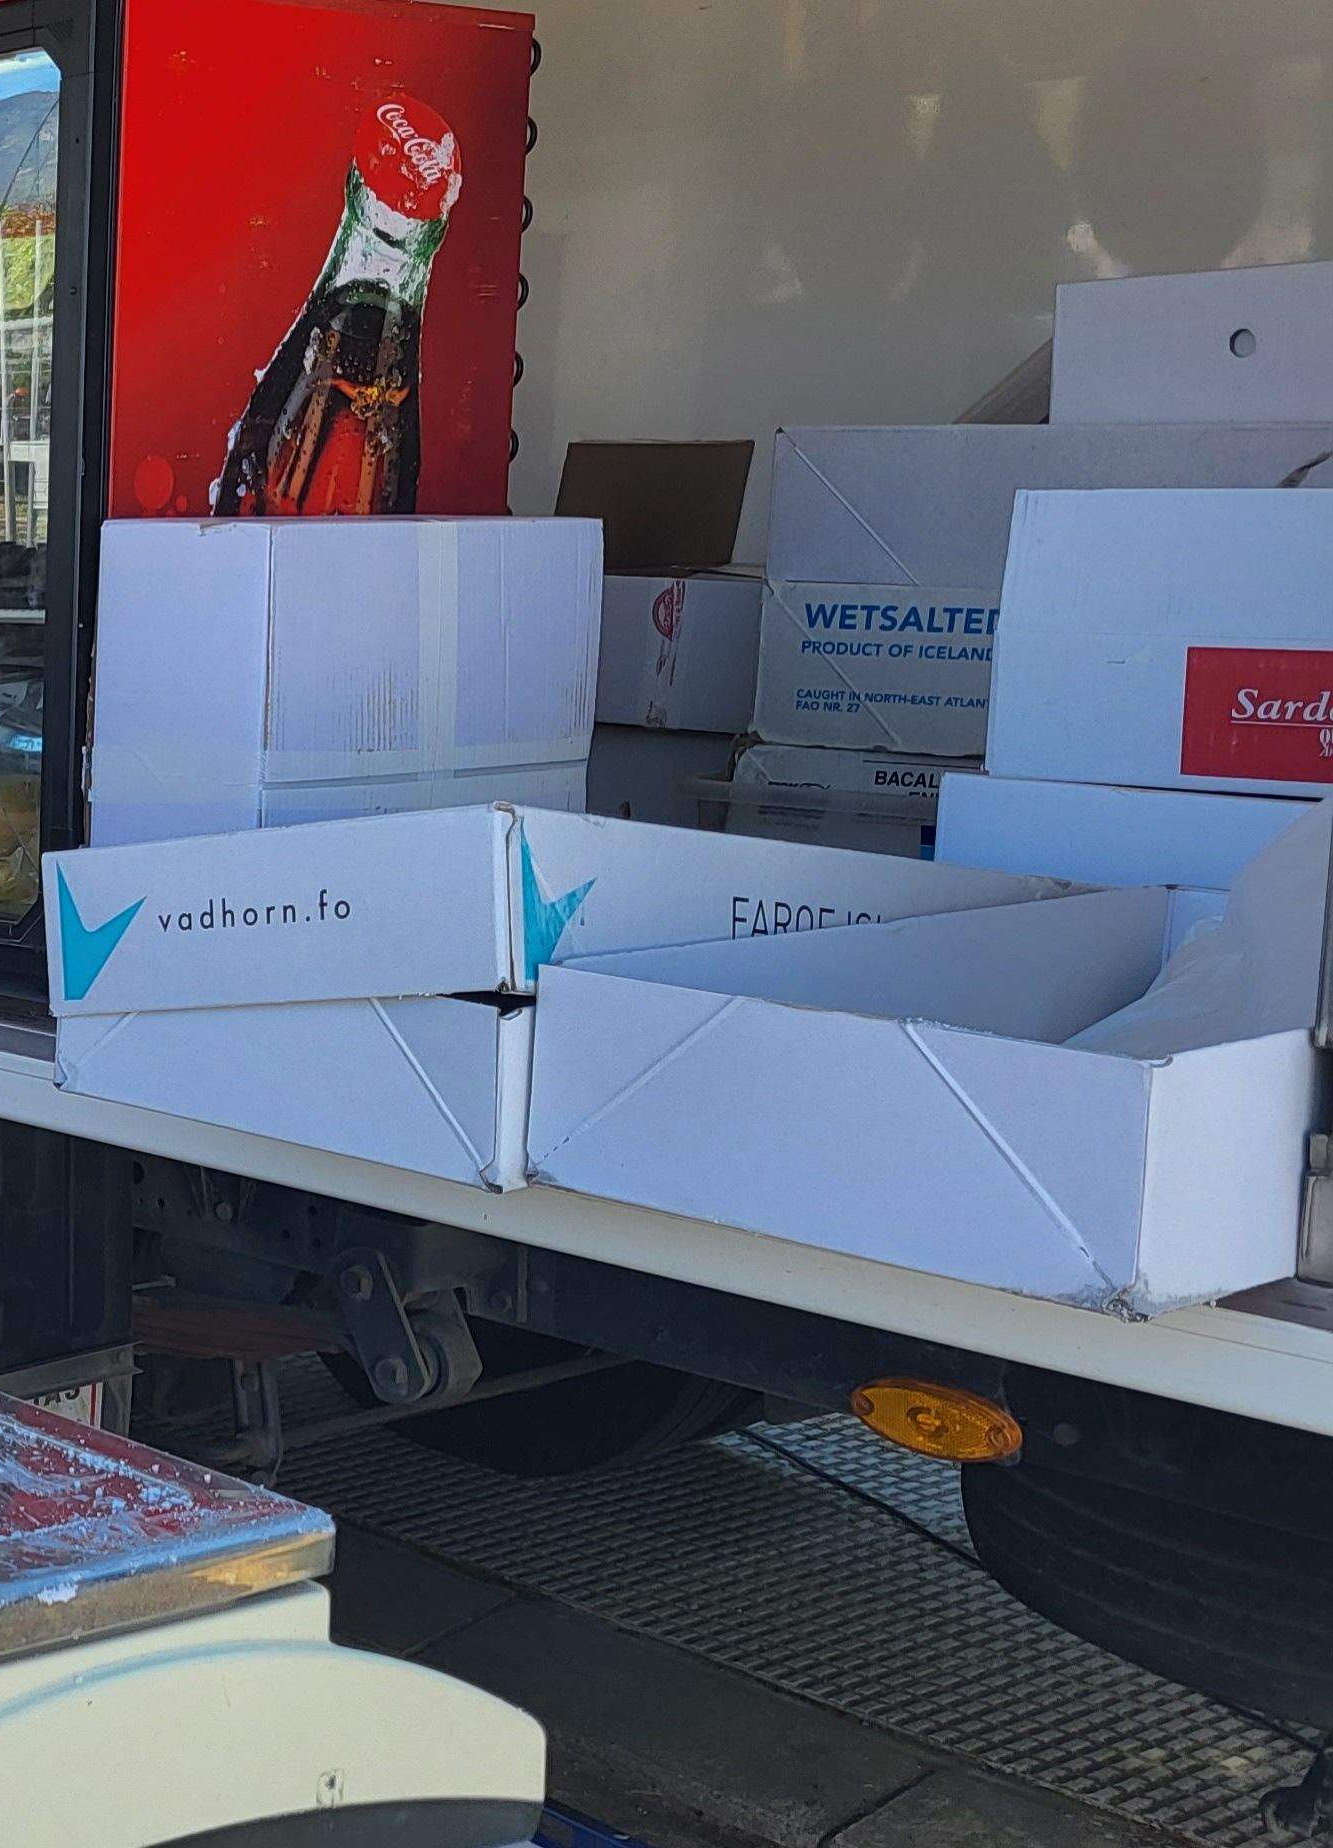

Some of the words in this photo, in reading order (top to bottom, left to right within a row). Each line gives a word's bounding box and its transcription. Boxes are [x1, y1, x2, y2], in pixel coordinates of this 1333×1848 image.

[801, 640, 883, 658] PRODUCT
[888, 643, 914, 659] OF
[795, 700, 820, 711] FAO
[823, 702, 843, 713] NR.
[846, 703, 860, 713] 27
[796, 689, 846, 701] CAUGHT
[848, 691, 861, 702] IN
[863, 692, 941, 706] NORTH-EAST
[1231, 688, 1333, 722] Sard
[158, 889, 351, 933] vadhorn.fo
